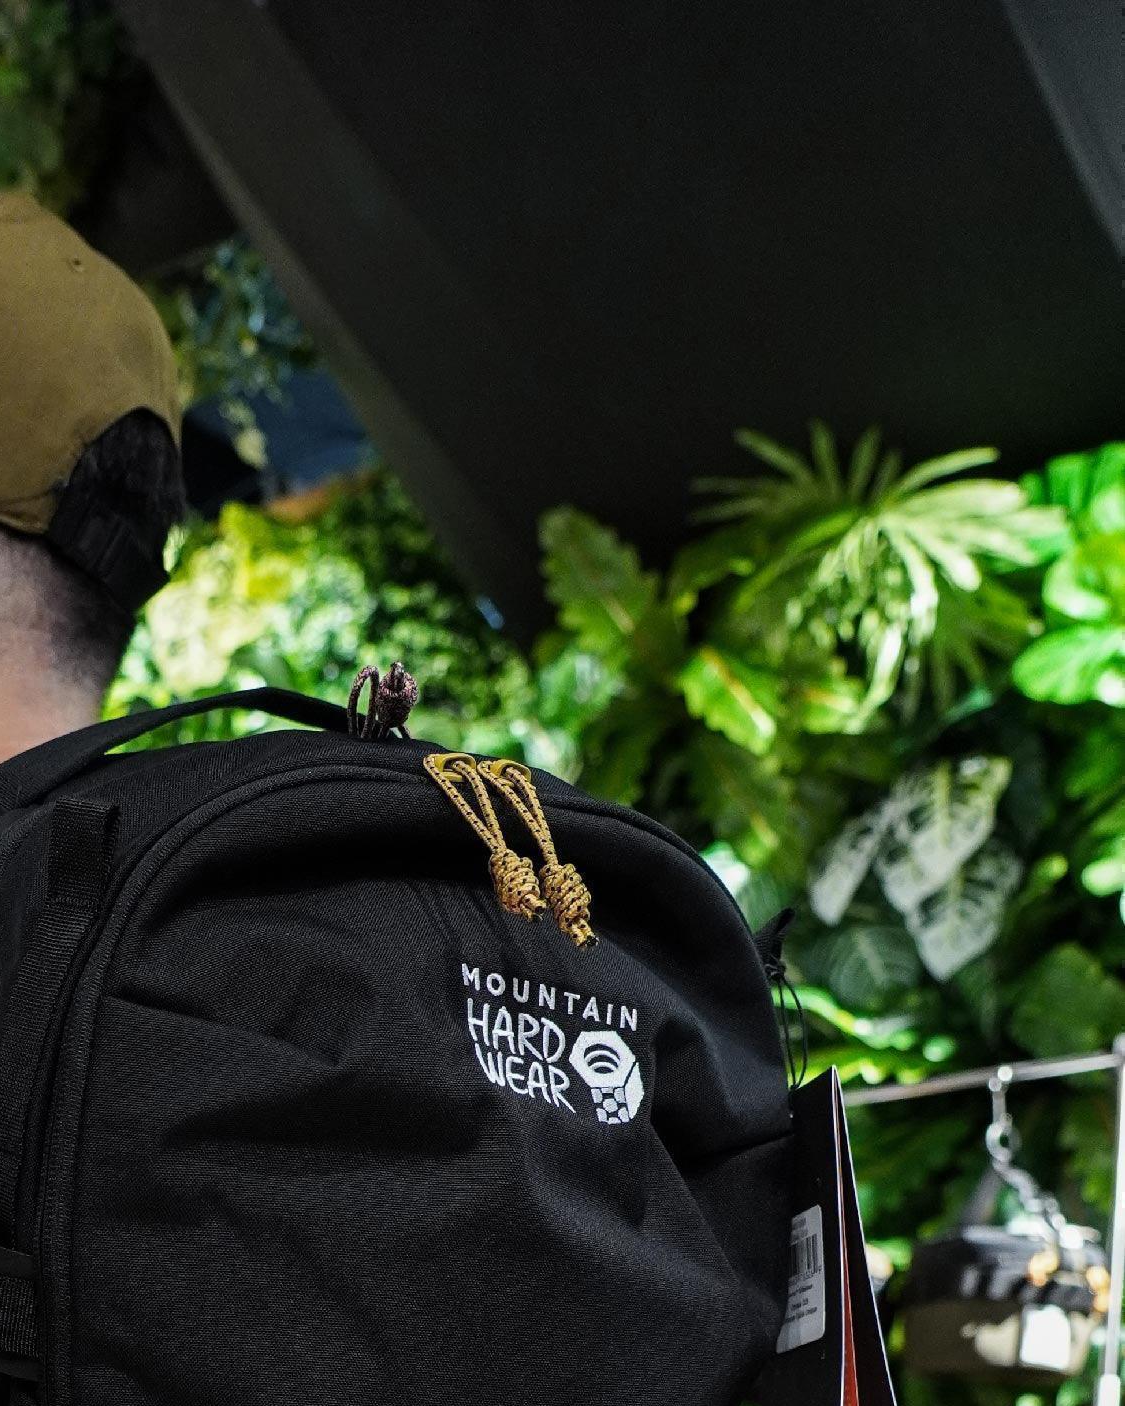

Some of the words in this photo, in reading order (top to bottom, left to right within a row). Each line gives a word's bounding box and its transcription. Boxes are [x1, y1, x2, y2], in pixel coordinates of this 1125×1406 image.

[461, 963, 638, 1032] MOUNTAIN
[467, 998, 566, 1063] HARD
[474, 1043, 576, 1113] WEAR
